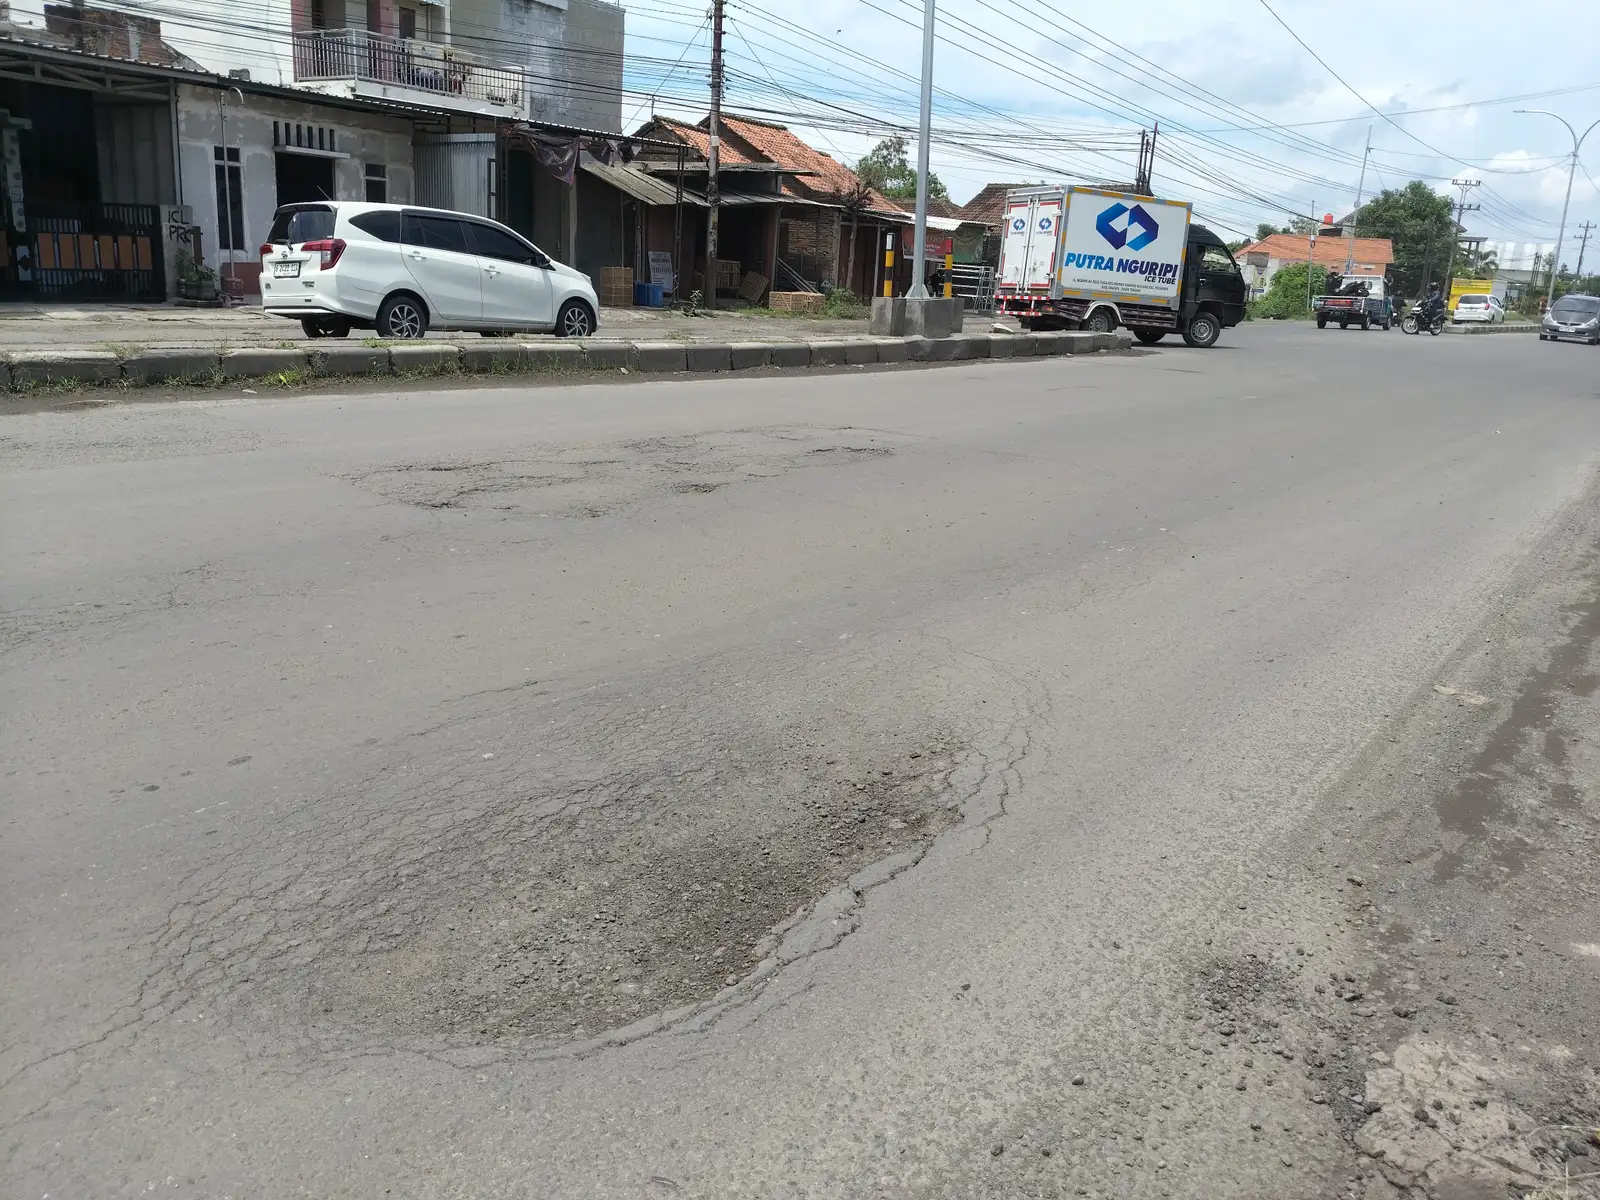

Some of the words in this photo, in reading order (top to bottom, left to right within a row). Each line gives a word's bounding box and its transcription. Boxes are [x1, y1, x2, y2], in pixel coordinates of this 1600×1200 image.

[1064, 252, 1114, 271] PUTRA
[1116, 258, 1179, 277] NGURIPI
[1144, 275, 1156, 283] ICE
[1158, 276, 1177, 285] TUBE
